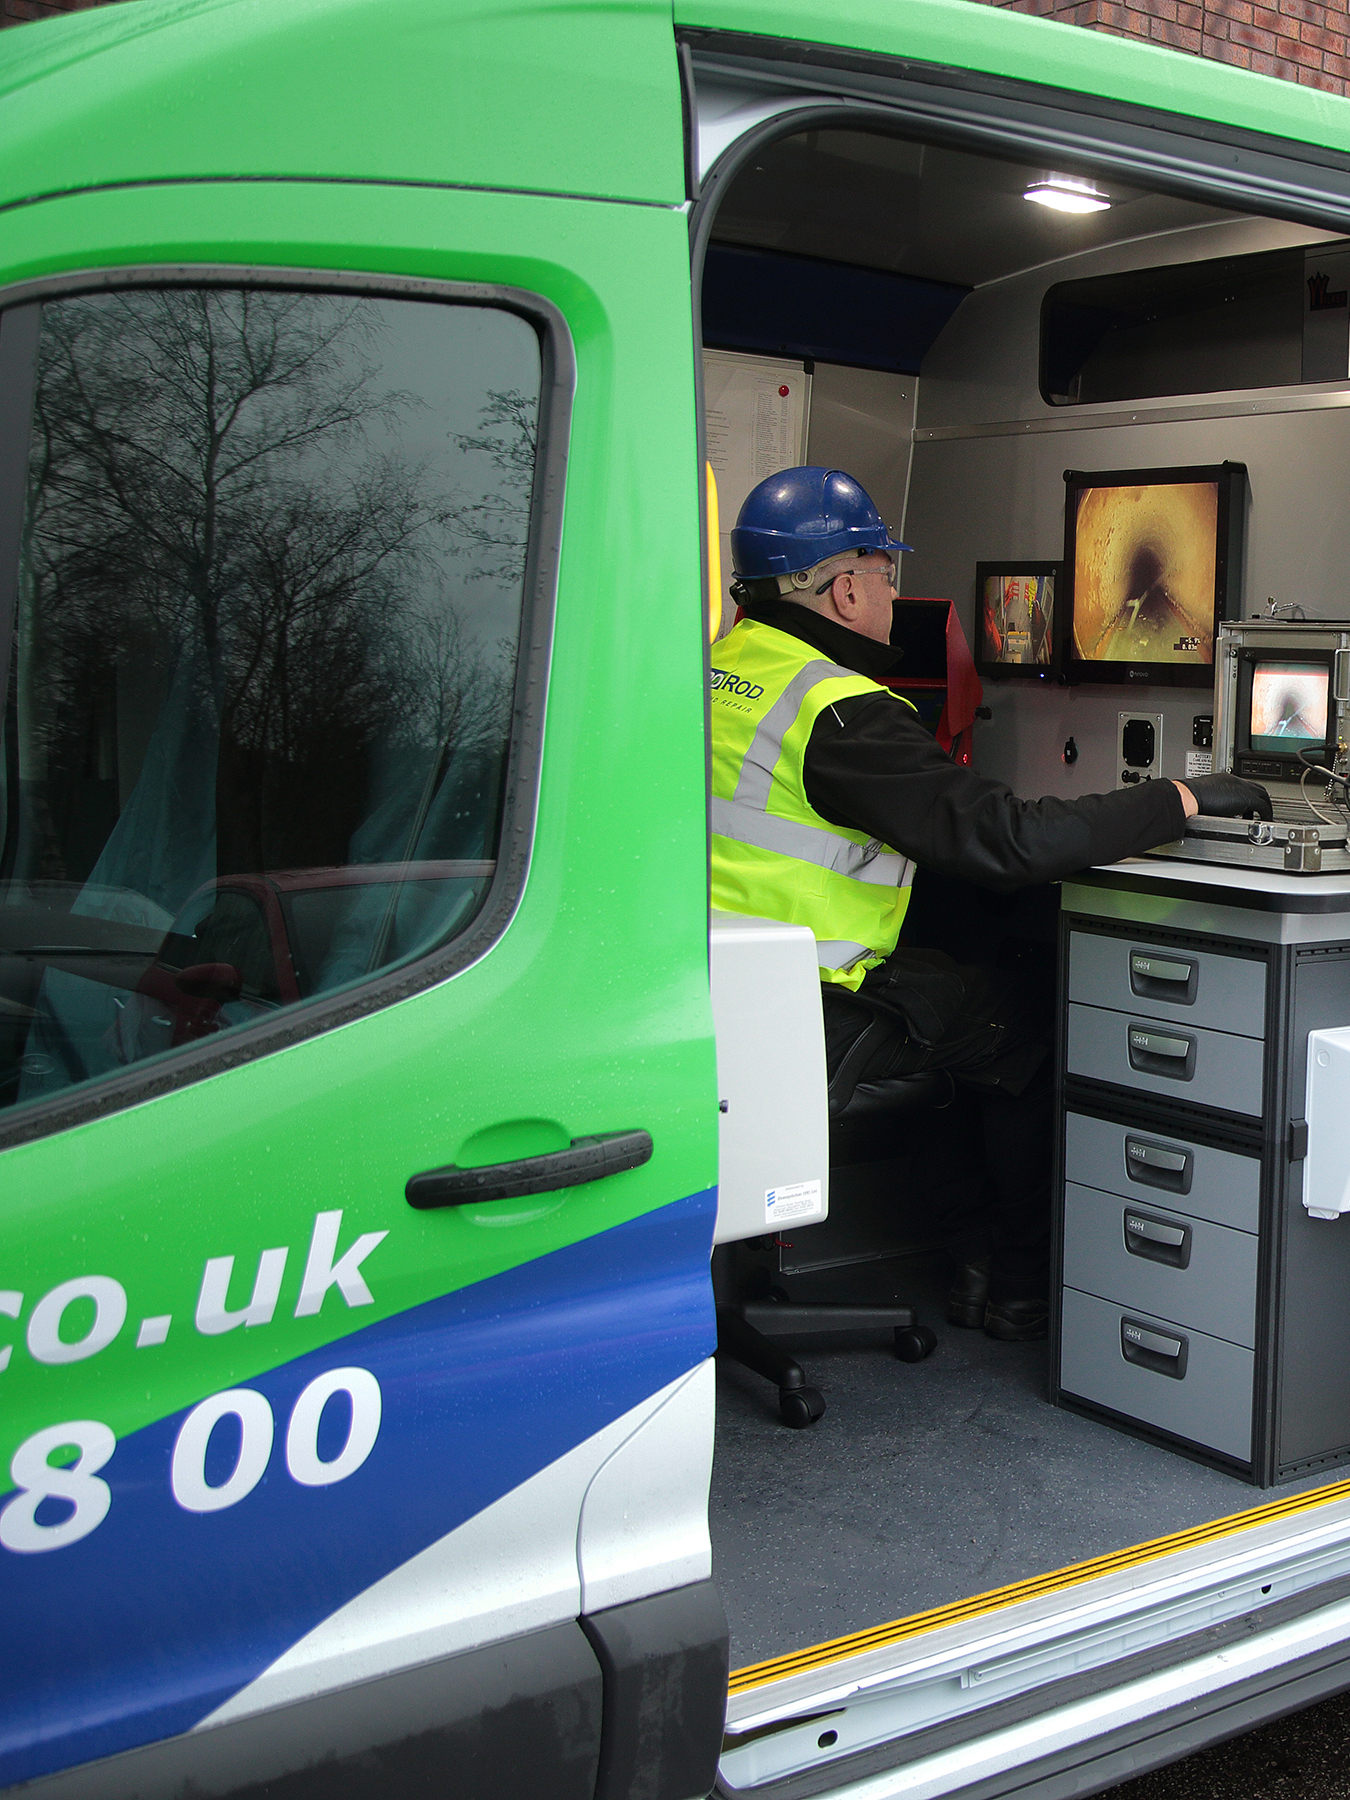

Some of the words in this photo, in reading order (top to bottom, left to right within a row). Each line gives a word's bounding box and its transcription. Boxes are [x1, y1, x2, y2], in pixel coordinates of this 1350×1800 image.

[720, 699, 753, 714] REPAIR
[0, 1209, 390, 1371] o.uk
[0, 1420, 117, 1554] 8
[171, 1366, 383, 1513] 00
